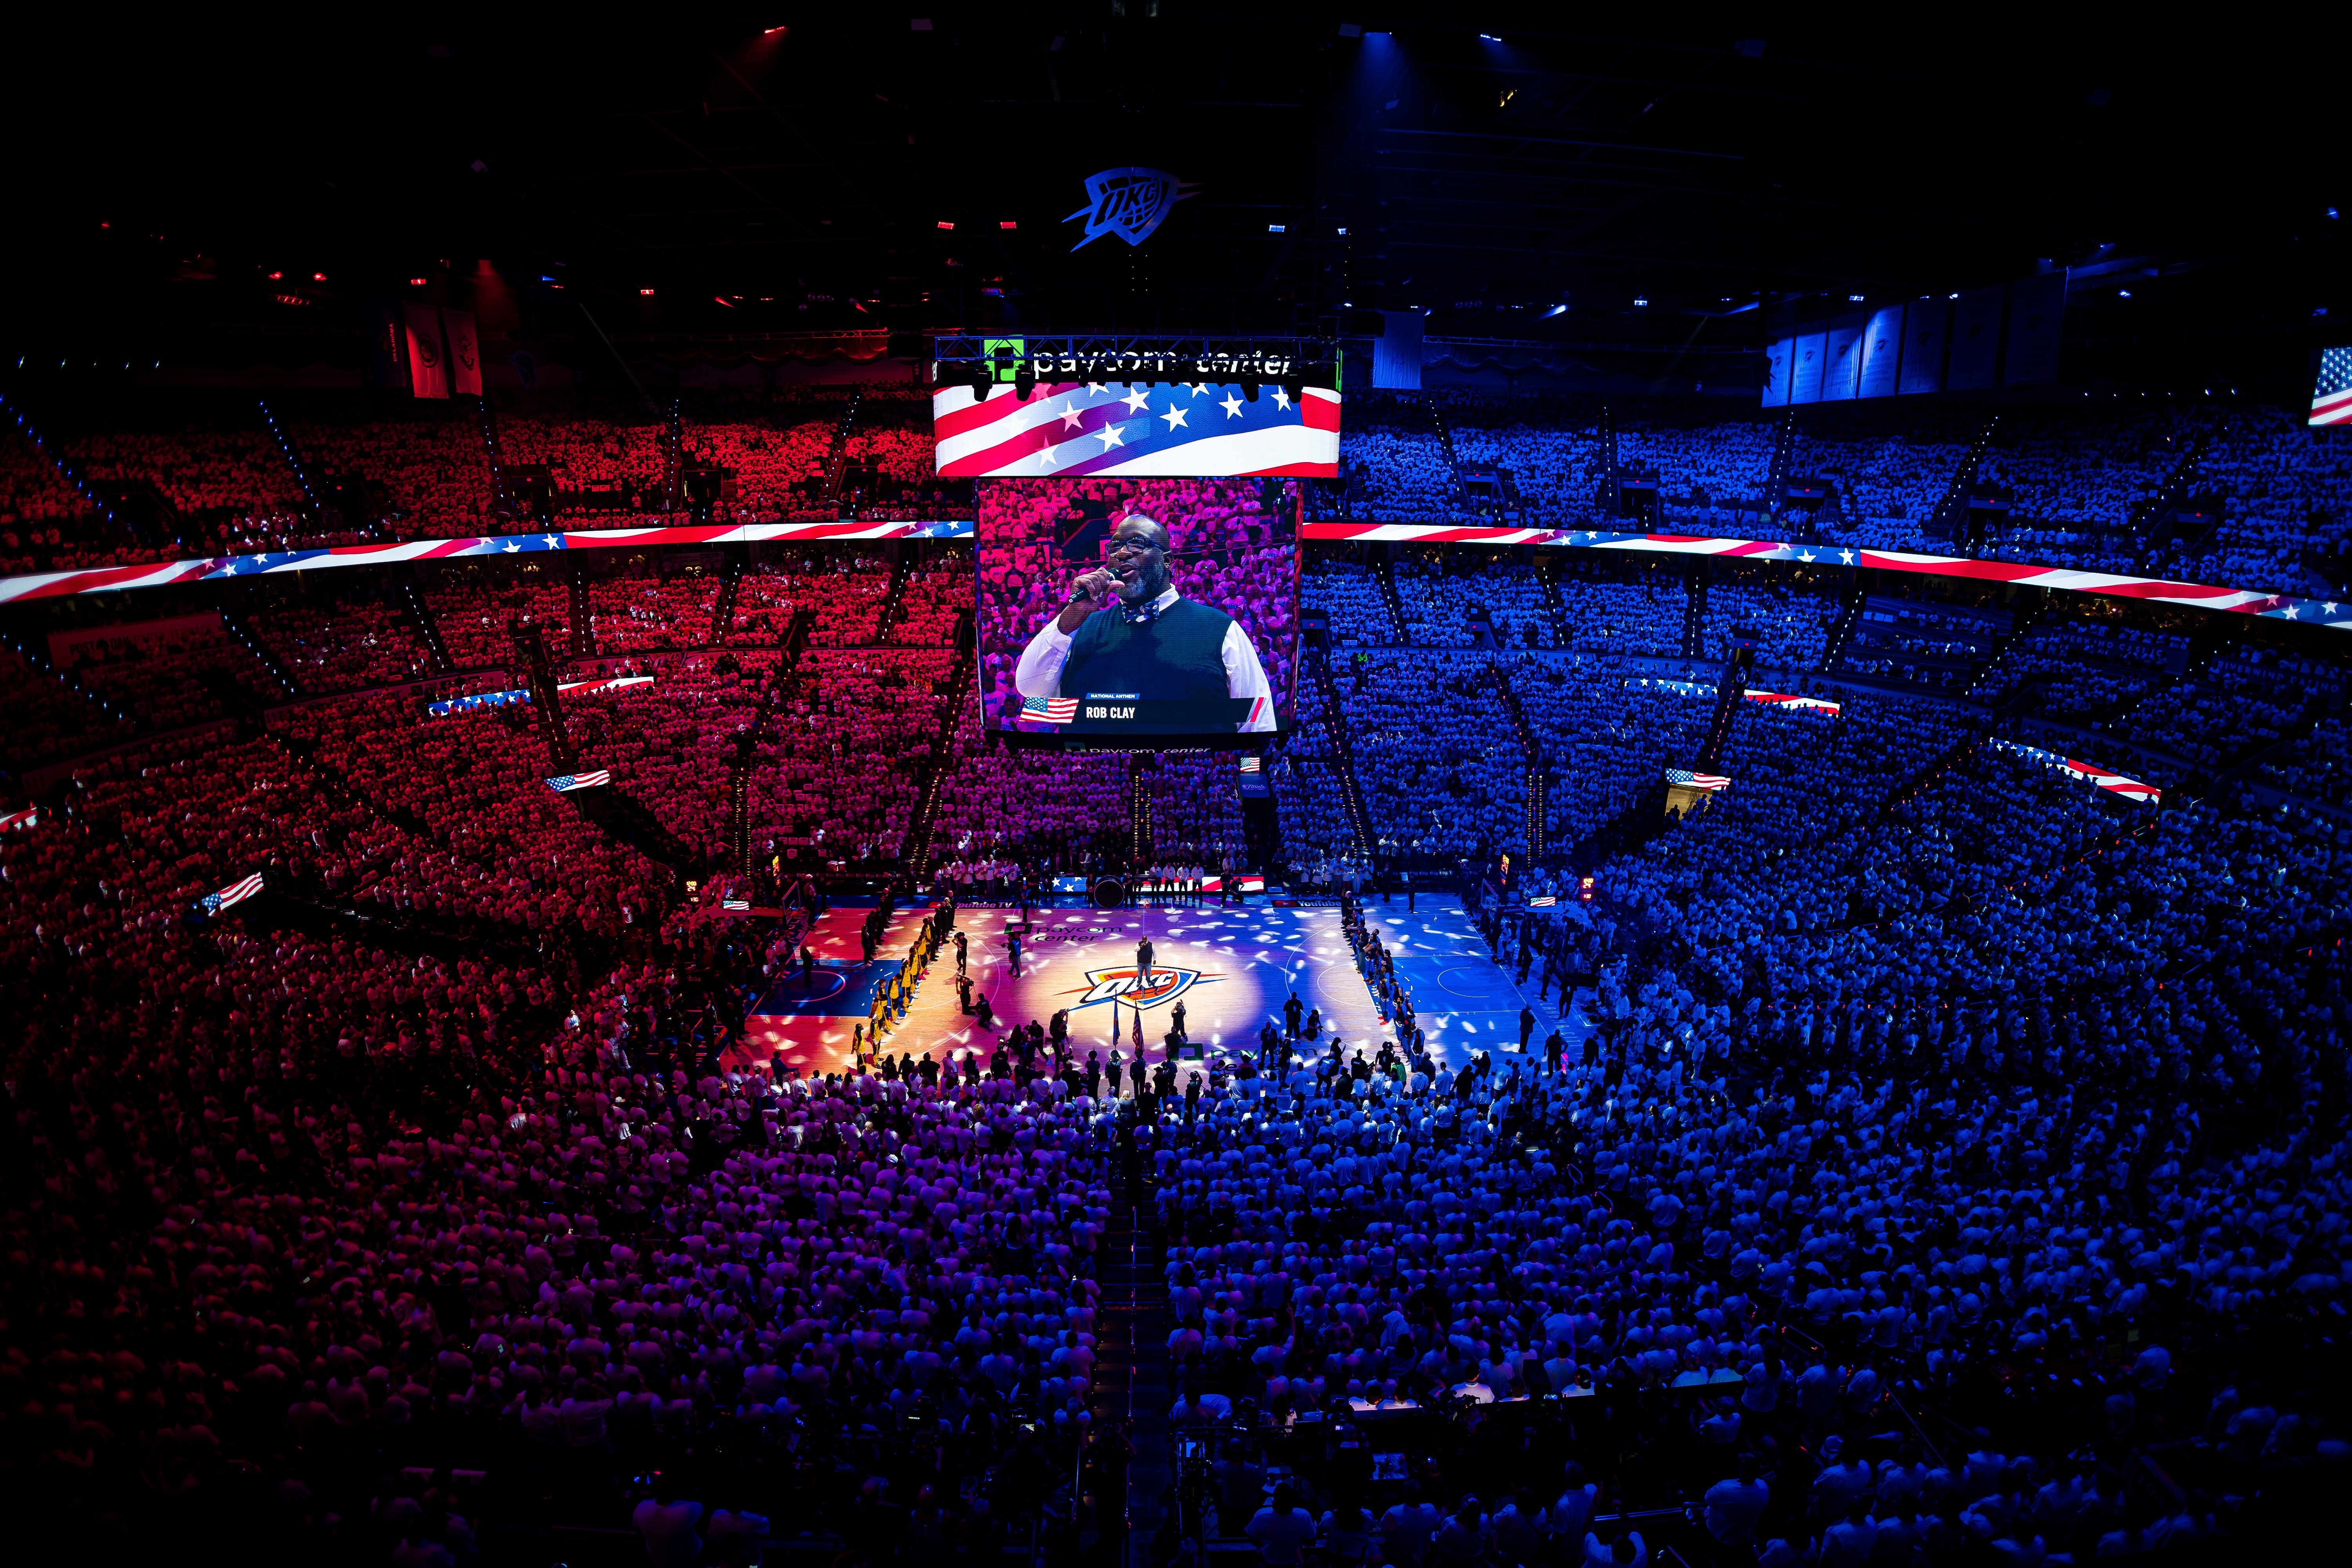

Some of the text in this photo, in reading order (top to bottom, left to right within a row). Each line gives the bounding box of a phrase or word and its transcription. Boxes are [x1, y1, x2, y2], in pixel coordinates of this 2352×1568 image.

[1093, 179, 1158, 227] OKC
[2050, 632, 2114, 649] IVERWIND
[70, 641, 94, 655] POST
[2218, 661, 2284, 681] RIVERWIND
[1086, 707, 1135, 719] ROB CLAY
[773, 863, 780, 876] 24
[1501, 864, 1509, 874] 24
[1210, 1050, 1318, 1060] paym
